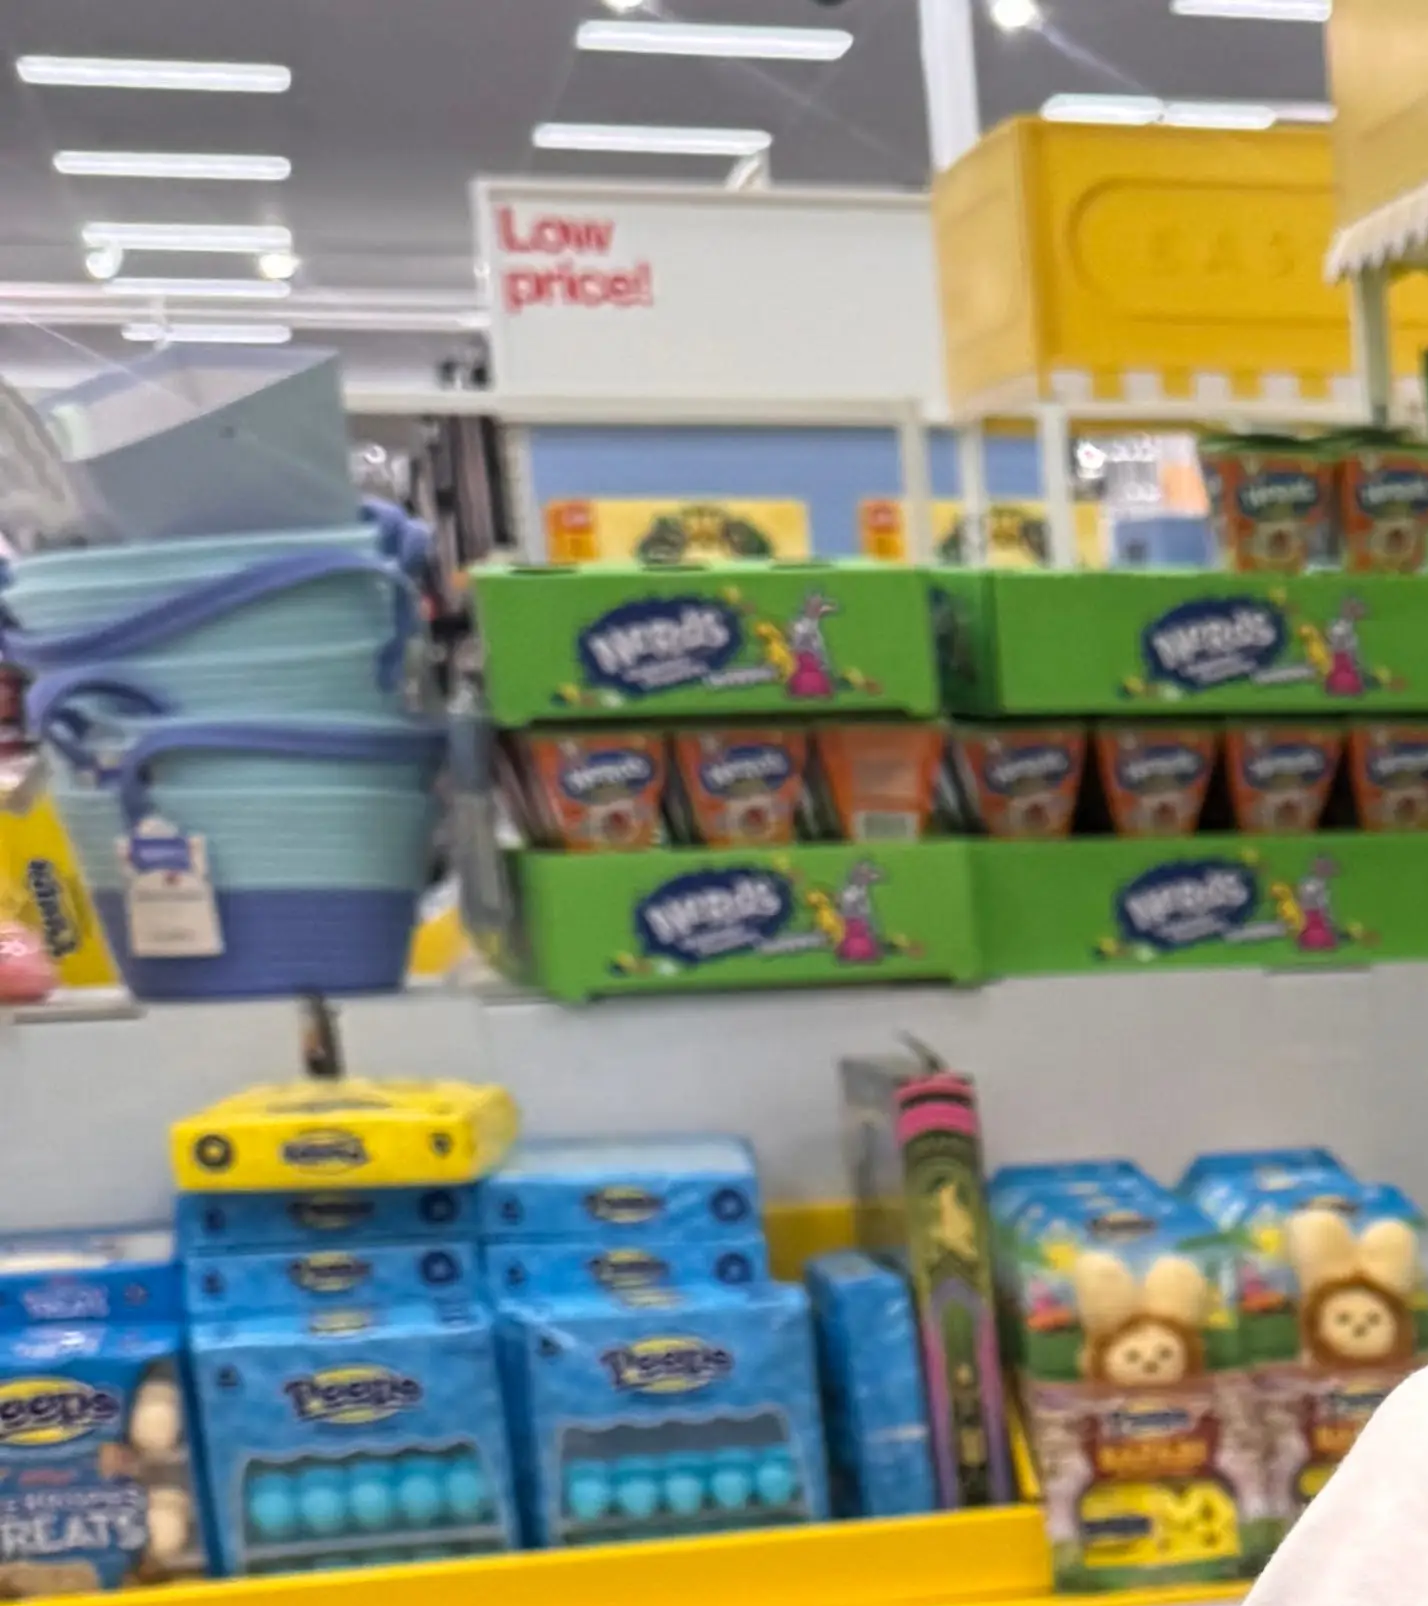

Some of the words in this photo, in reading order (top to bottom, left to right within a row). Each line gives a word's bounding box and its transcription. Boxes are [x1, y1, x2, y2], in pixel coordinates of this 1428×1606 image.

[496, 205, 615, 253] Low
[505, 258, 653, 316] price!
[0, 1391, 122, 1440] eeps
[283, 1375, 422, 1421] Peeps
